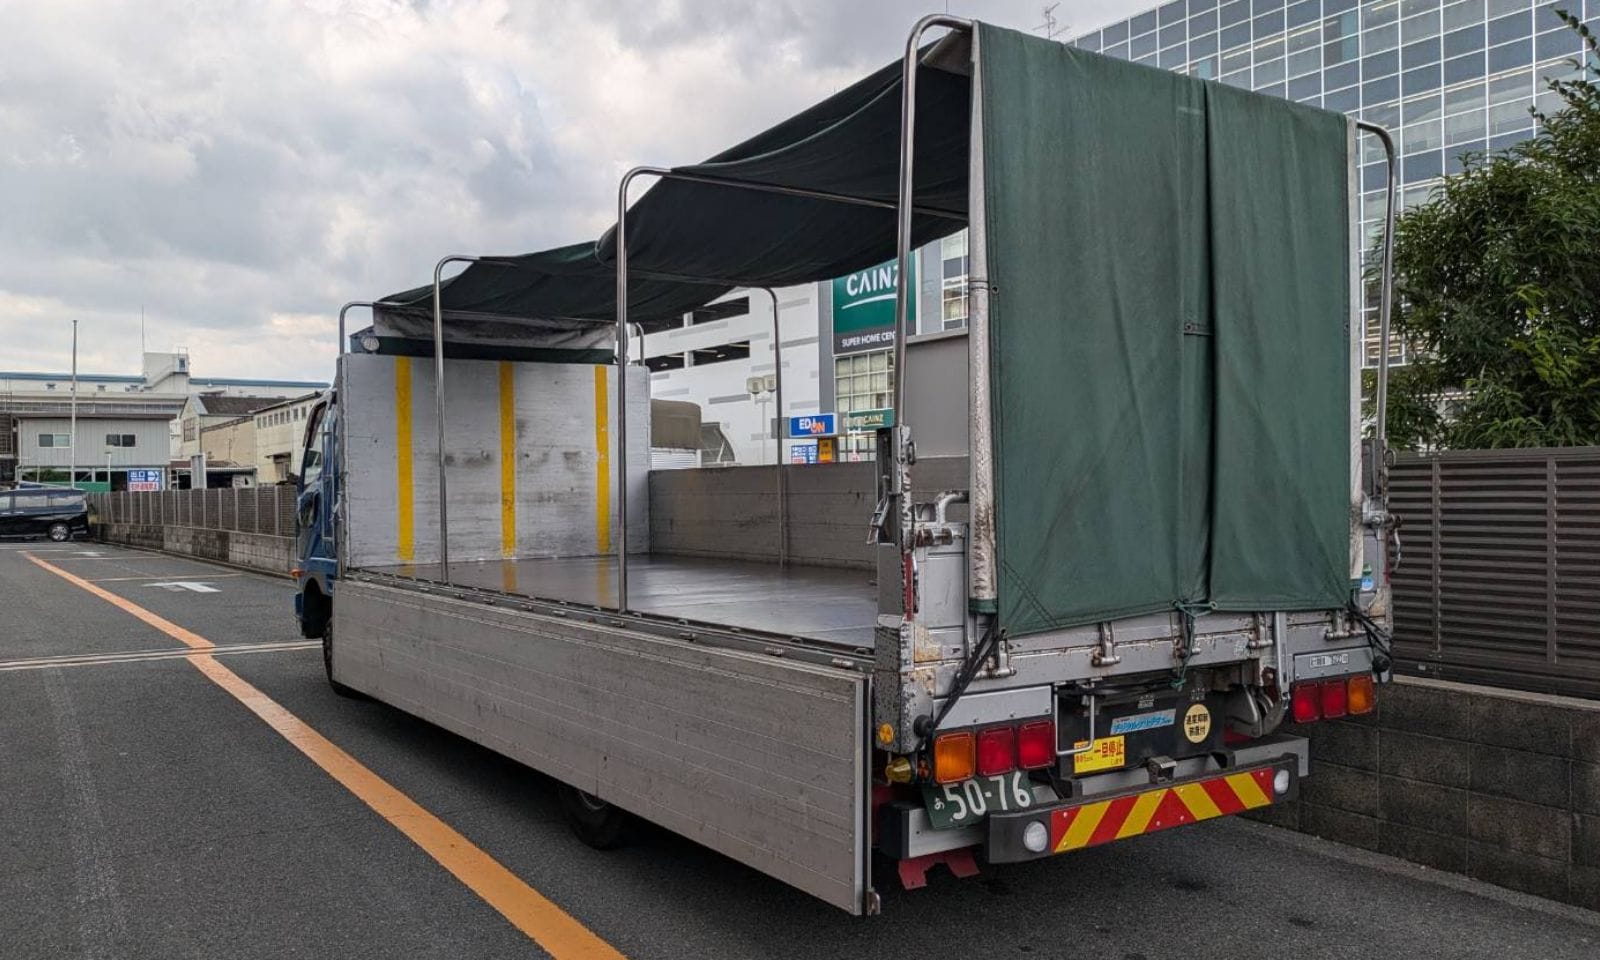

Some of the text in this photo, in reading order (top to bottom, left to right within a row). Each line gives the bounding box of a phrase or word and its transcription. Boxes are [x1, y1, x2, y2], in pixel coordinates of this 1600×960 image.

[841, 336, 861, 348] SUPER
[861, 333, 880, 344] HOME
[799, 418, 825, 433] EDION
[1093, 739, 1123, 758] 一旦停止
[942, 770, 1032, 820] 50-76
